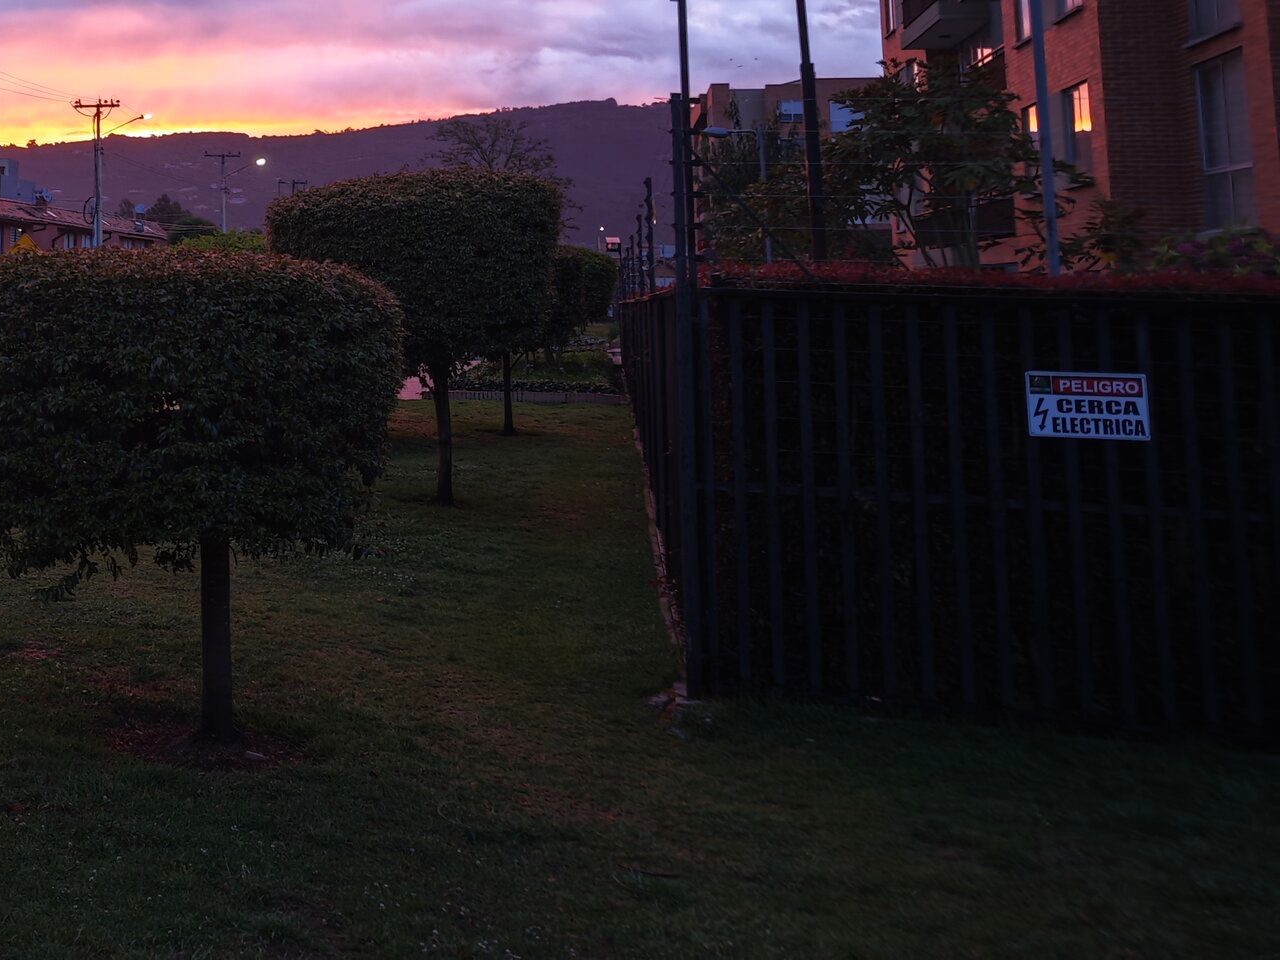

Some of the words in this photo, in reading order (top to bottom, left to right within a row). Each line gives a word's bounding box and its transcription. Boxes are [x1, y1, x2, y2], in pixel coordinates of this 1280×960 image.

[1059, 379, 1139, 395] PELIGRO
[1057, 398, 1140, 416] CERCA
[1052, 417, 1146, 436] ELECTRICA
